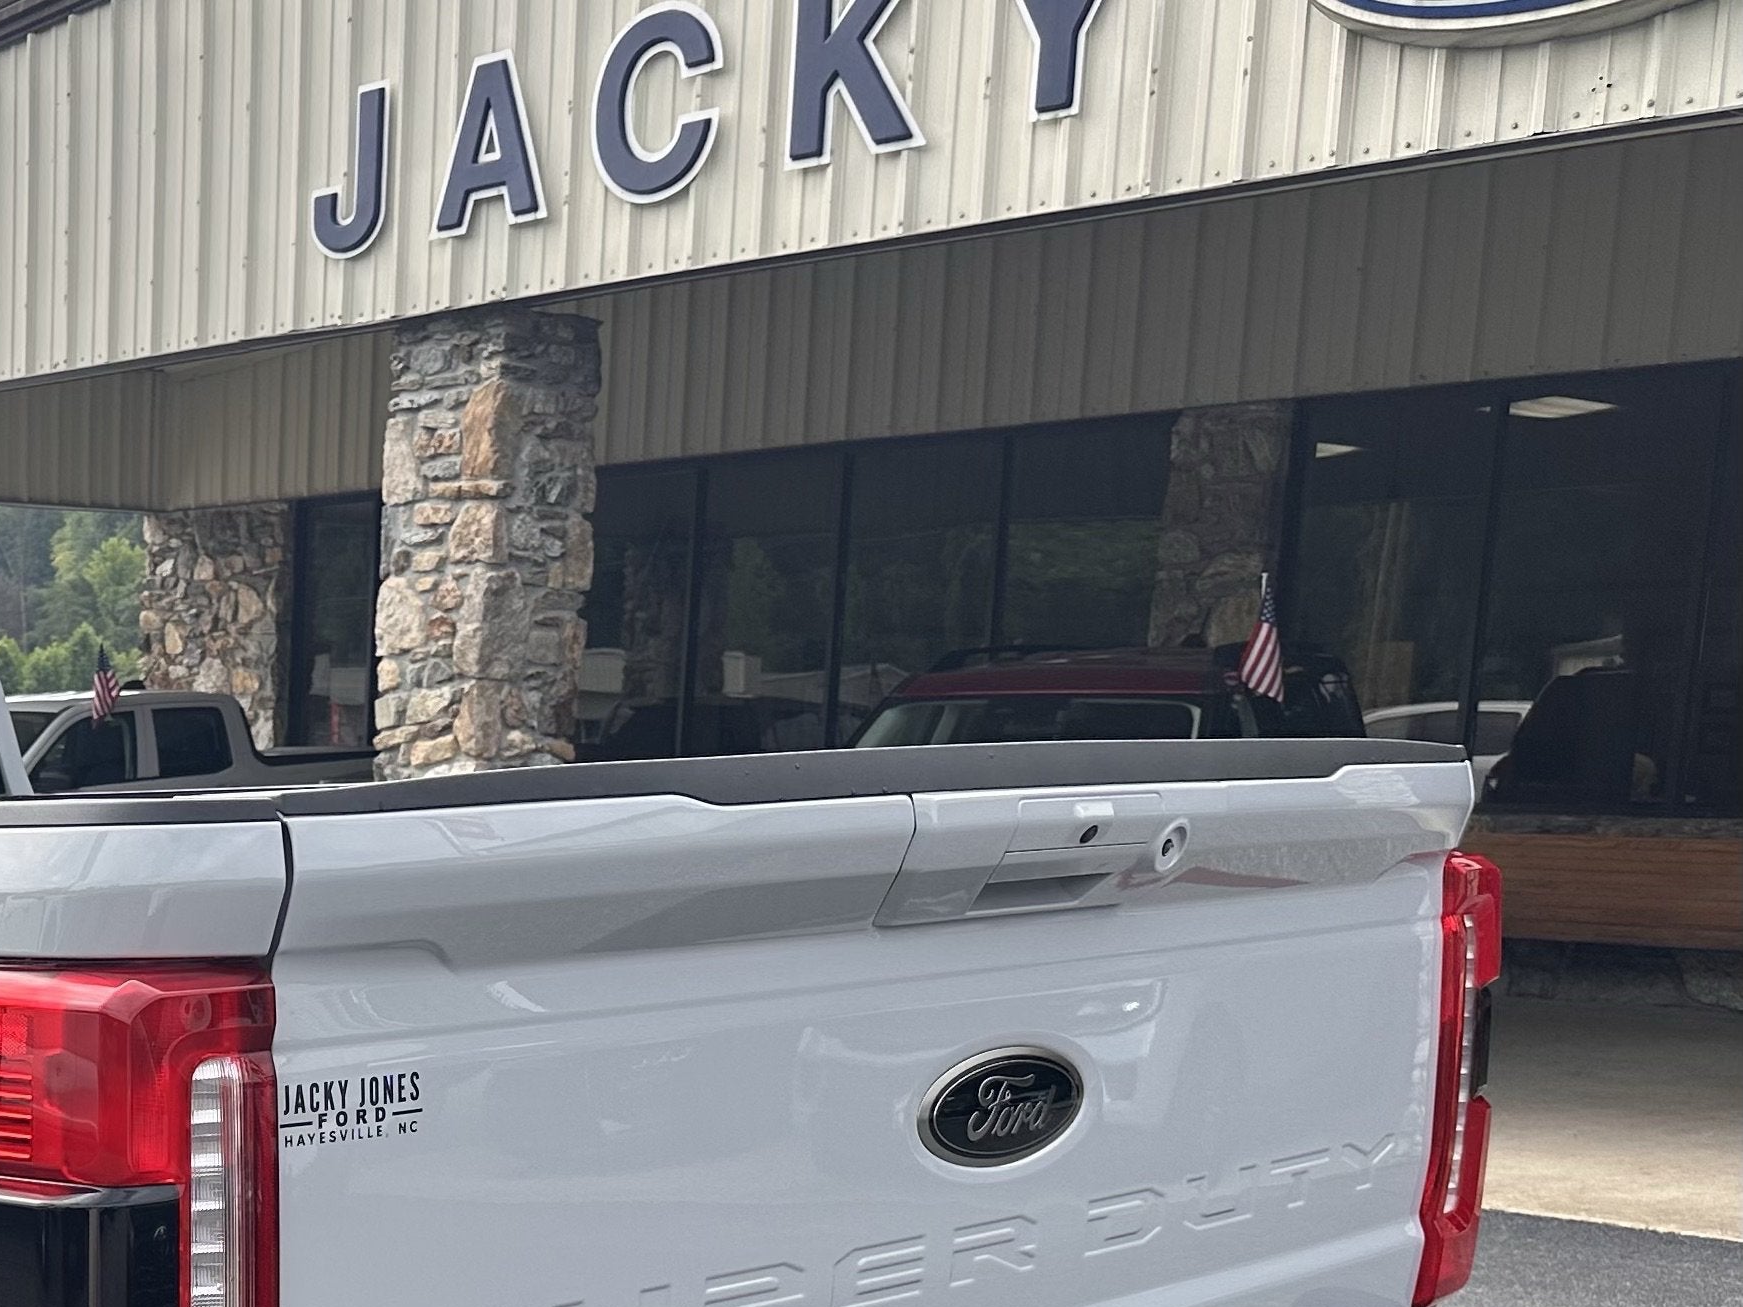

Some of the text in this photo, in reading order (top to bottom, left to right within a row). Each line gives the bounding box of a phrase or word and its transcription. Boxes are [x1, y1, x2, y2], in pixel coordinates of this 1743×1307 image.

[310, 0, 1100, 260] JACKY
[283, 1071, 420, 1116] JACKY JONES
[317, 1106, 387, 1129] FORD
[967, 1073, 1057, 1142] Ford
[398, 1120, 418, 1135] NC
[1085, 1132, 1397, 1257] DUTY
